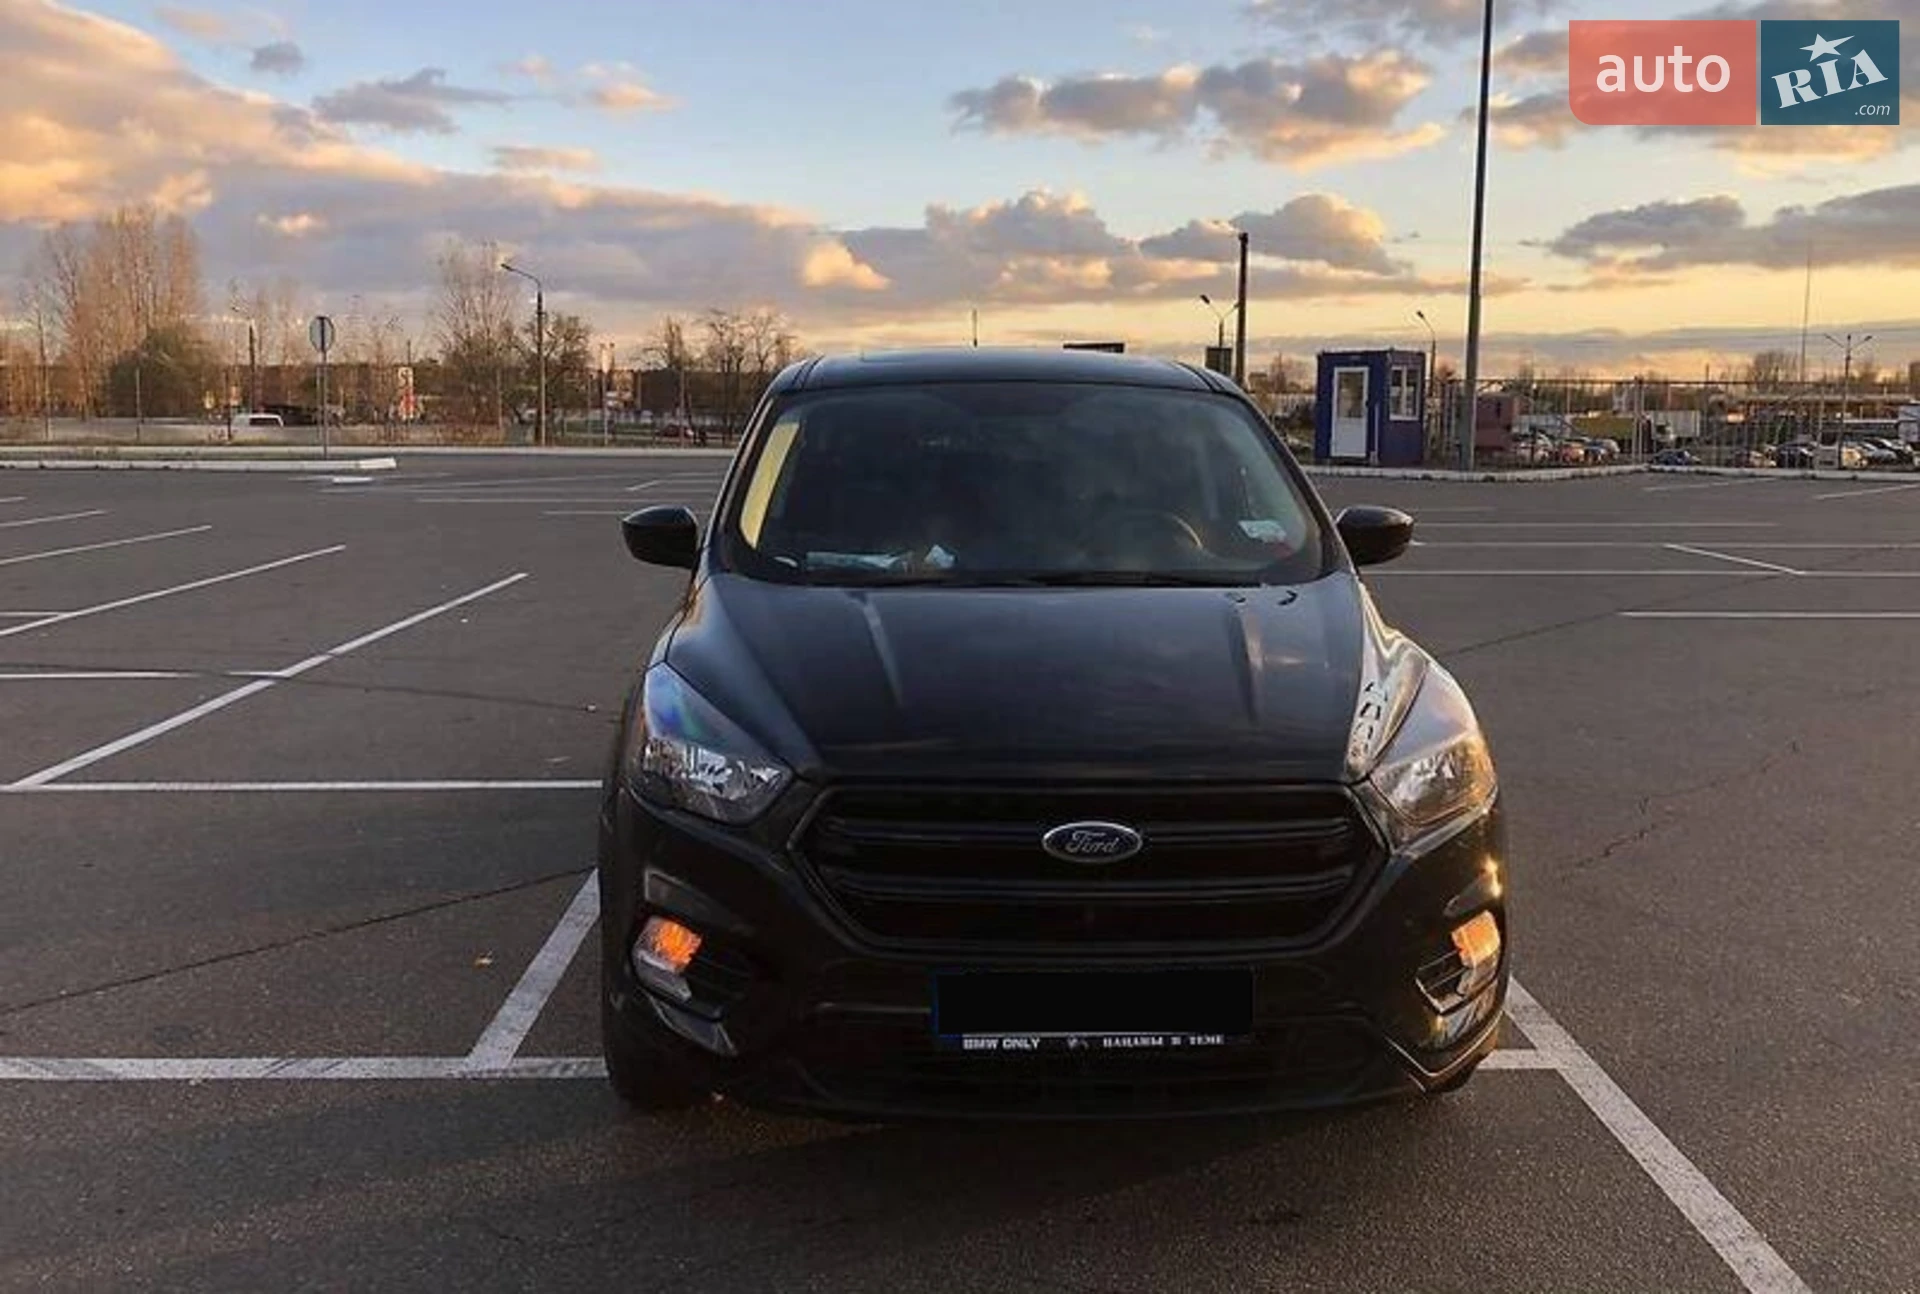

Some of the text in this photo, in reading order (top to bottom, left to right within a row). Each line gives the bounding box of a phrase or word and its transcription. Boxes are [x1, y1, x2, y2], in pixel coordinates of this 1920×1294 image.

[1065, 830, 1120, 853] Ford
[963, 1038, 1041, 1050] BMW ONLY
